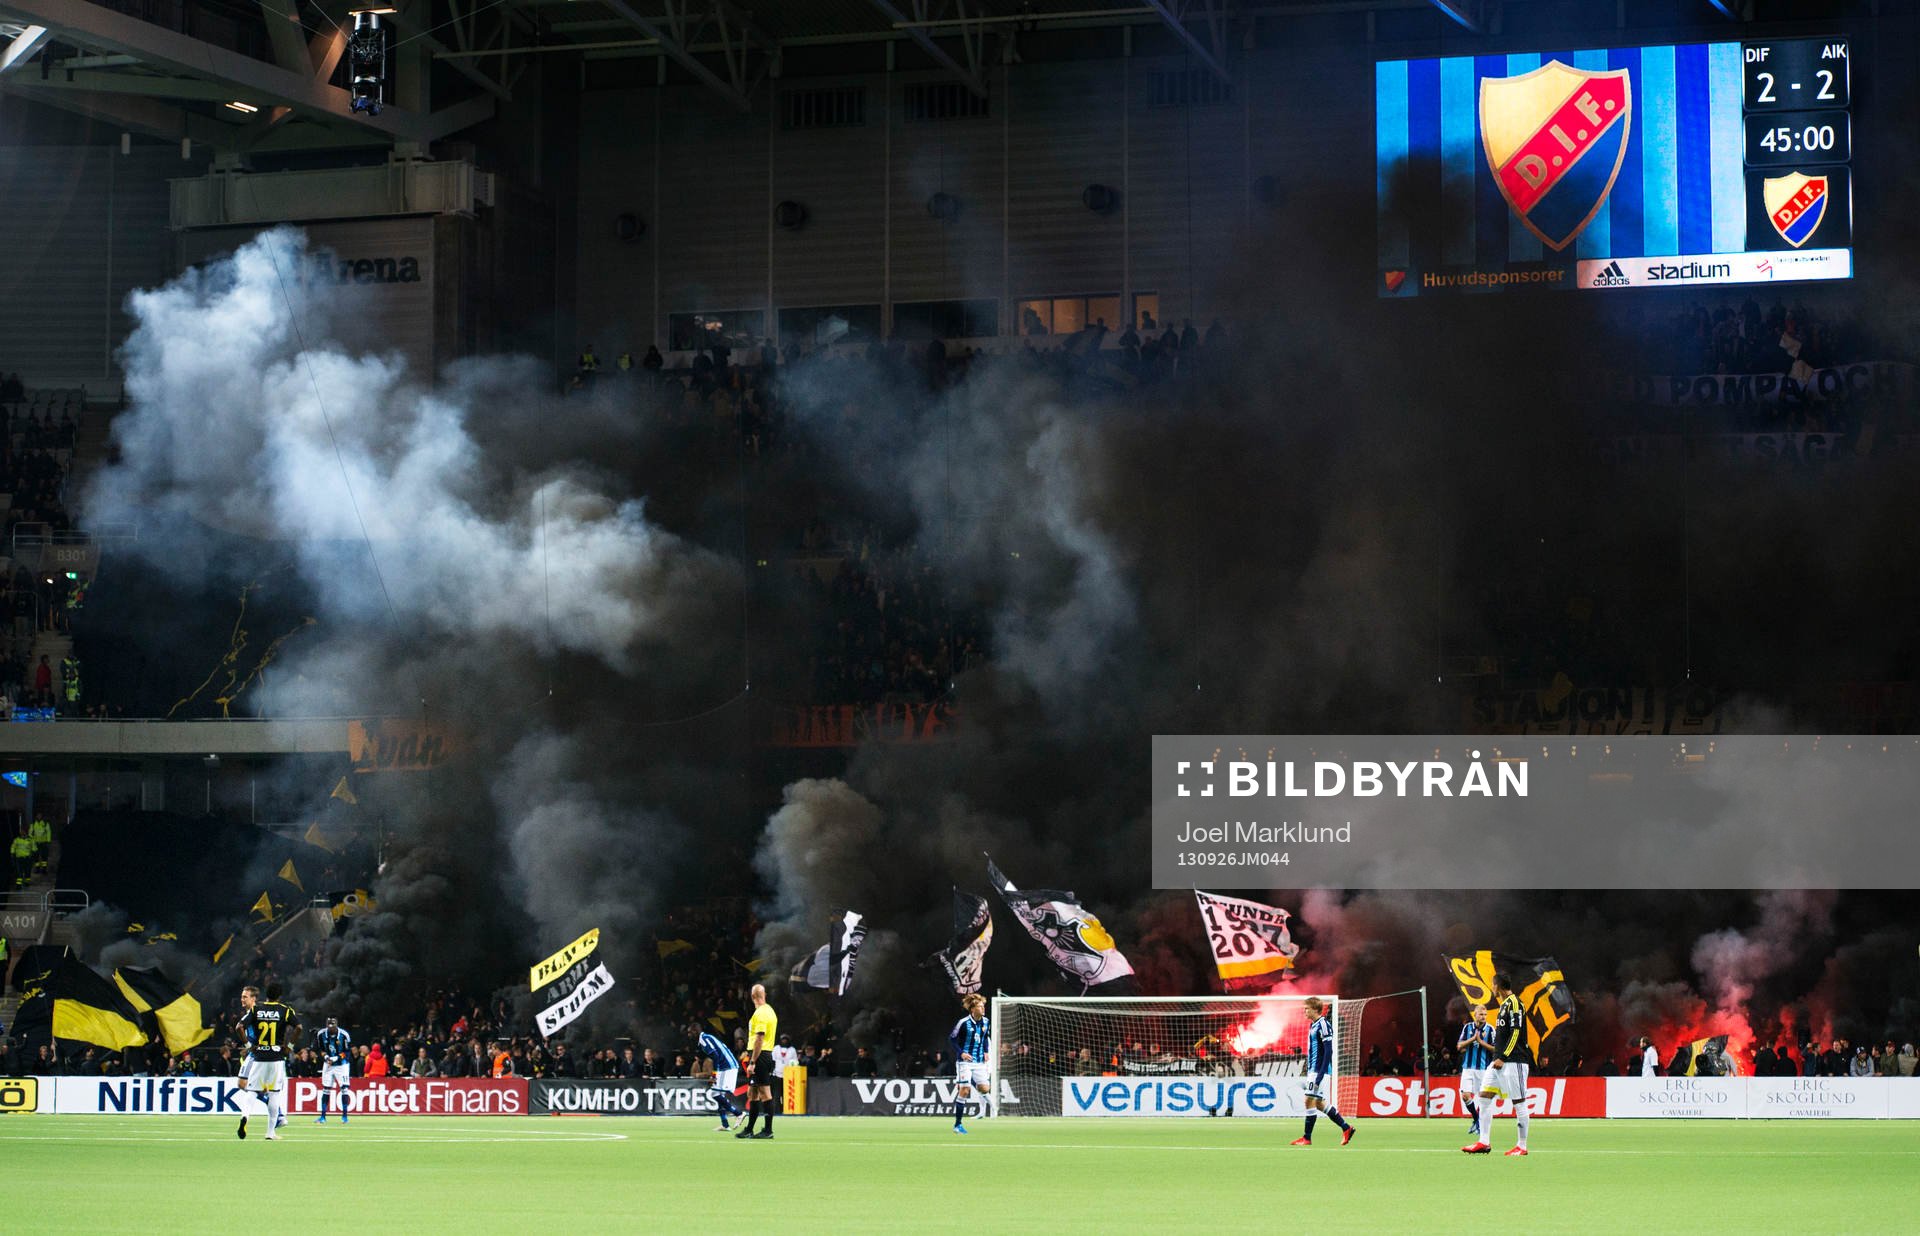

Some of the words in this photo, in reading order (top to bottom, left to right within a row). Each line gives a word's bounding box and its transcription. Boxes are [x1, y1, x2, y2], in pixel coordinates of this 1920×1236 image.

[1745, 48, 1770, 62] DIF
[1821, 44, 1846, 59] AIK
[1757, 73, 1776, 102] 2
[1816, 70, 1835, 100] 2
[1760, 126, 1835, 153] 45:00
[313, 254, 421, 286] Arena
[1423, 268, 1565, 288] Huvudsponsorer
[1647, 262, 1730, 281] stadium
[1592, 275, 1631, 287] adidas
[57, 549, 88, 561] B301
[3, 915, 36, 928] A101
[257, 1010, 280, 1018] SVEA
[258, 1021, 277, 1046] 21
[1666, 1079, 1702, 1090] ERIC
[1794, 1079, 1830, 1090] ERIC
[98, 1079, 241, 1112] Nilfisk
[426, 1082, 519, 1112] Finans
[548, 1088, 638, 1110] KUMHO
[644, 1088, 719, 1110] TYRES
[1071, 1082, 1276, 1112] verisure
[1639, 1092, 1728, 1104] SKOGLUND
[1766, 1092, 1856, 1104] SKOGLUND
